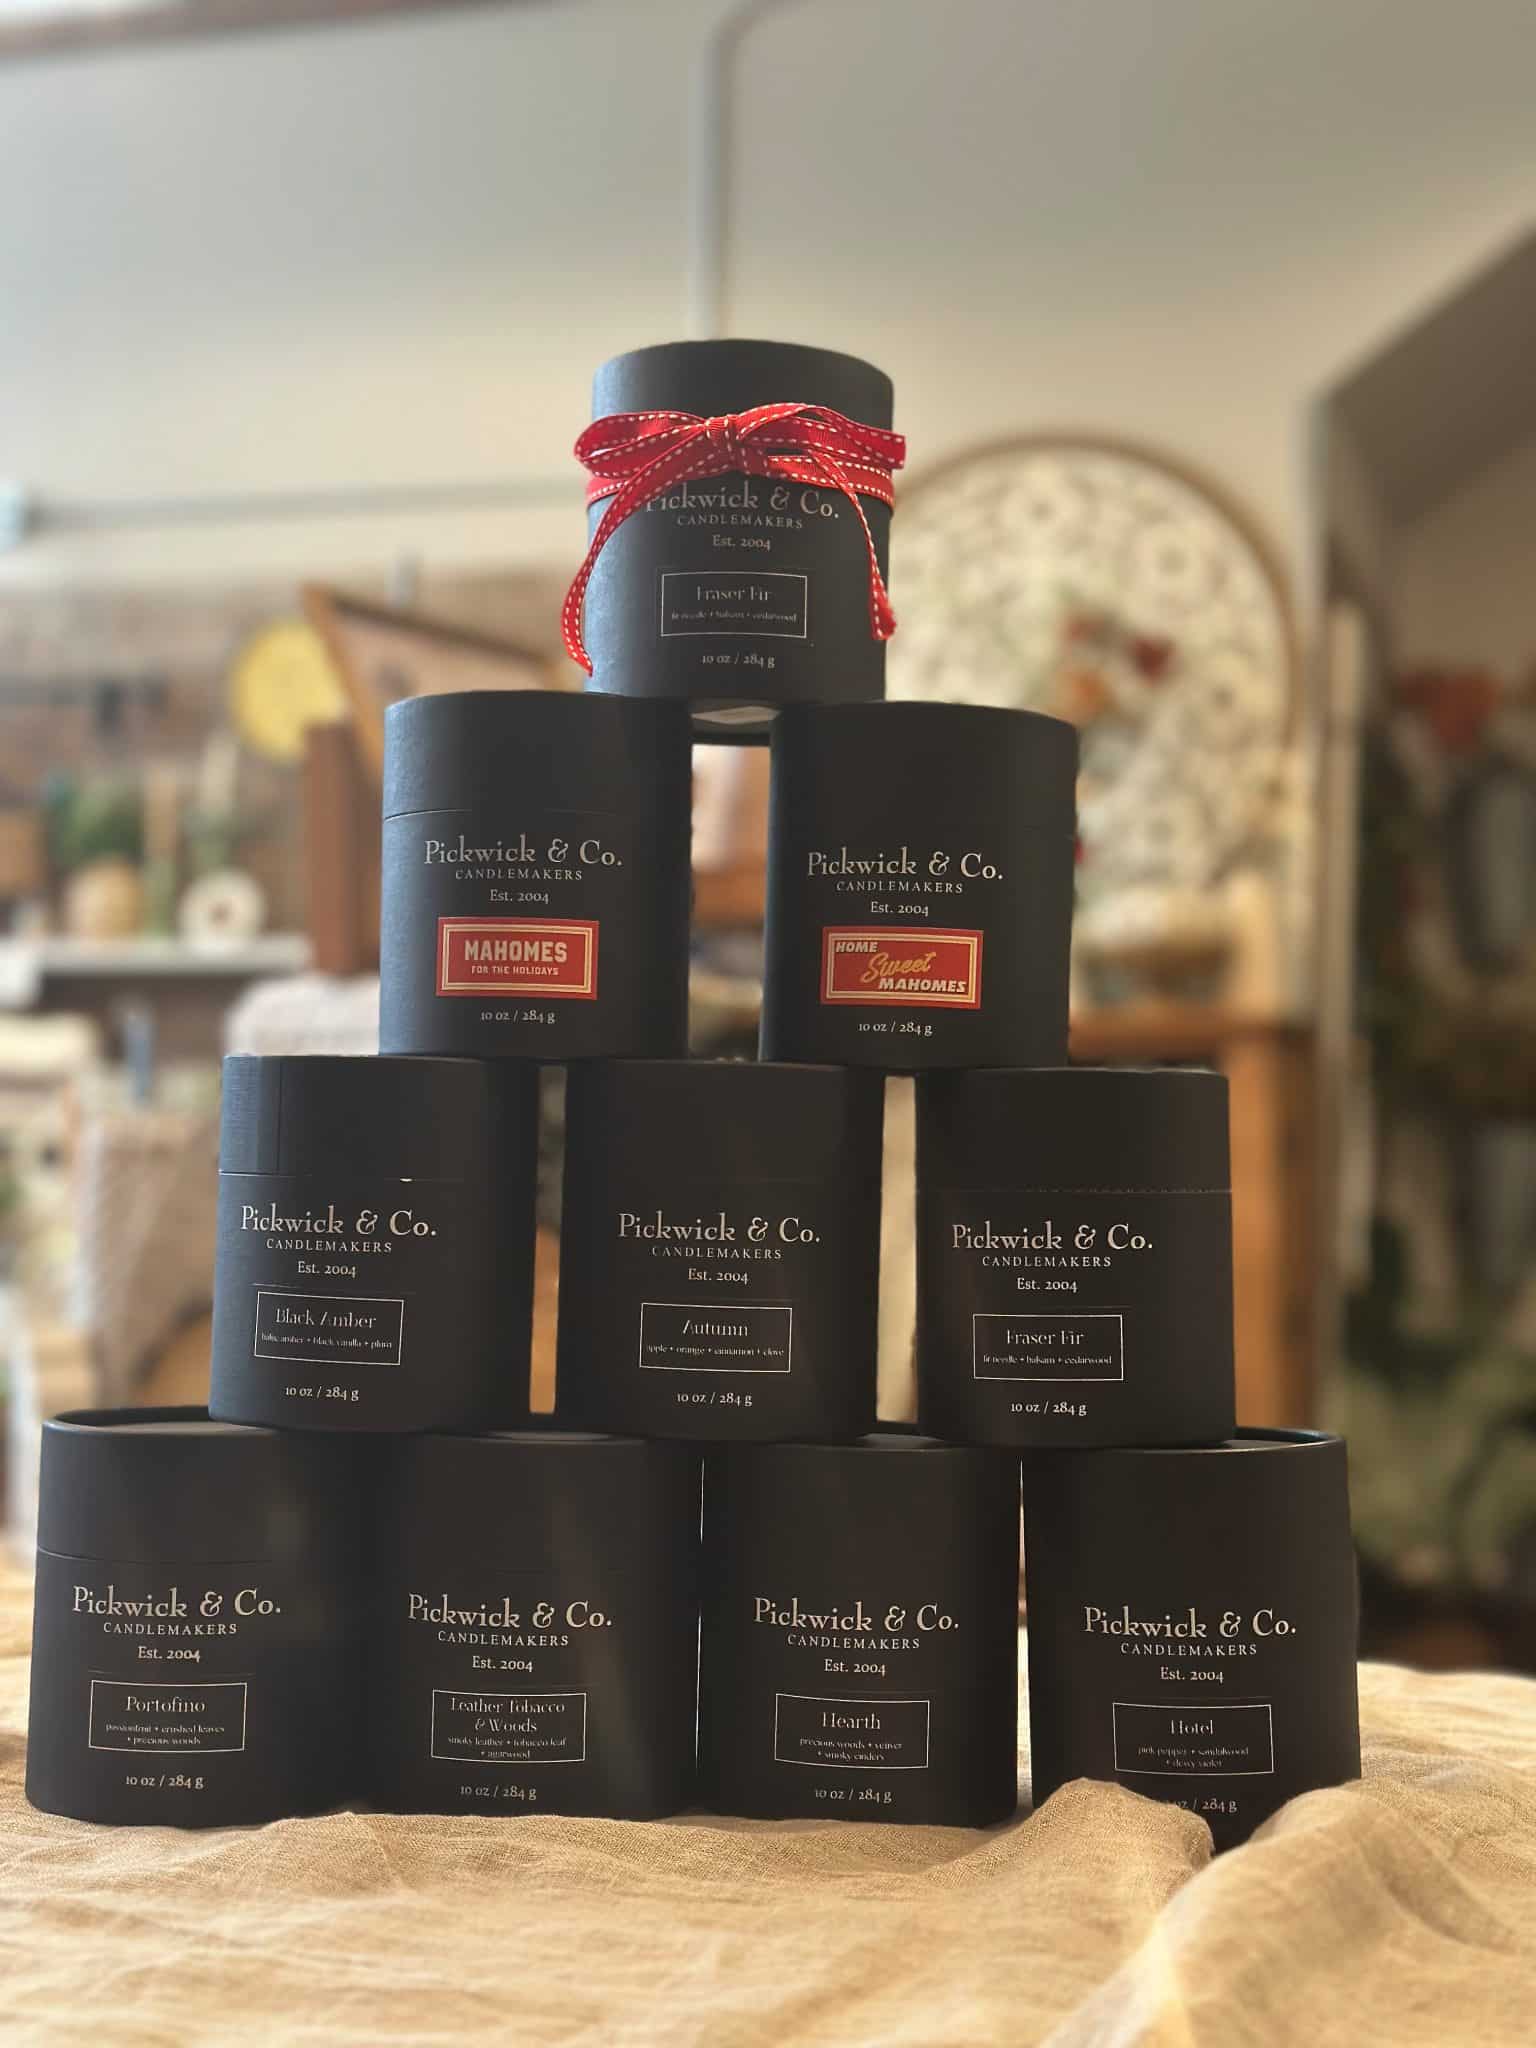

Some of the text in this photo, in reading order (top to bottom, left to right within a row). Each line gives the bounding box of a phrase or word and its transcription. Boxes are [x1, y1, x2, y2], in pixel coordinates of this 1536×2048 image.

[770, 487, 790, 510] &
[801, 491, 839, 518] Co.
[677, 514, 802, 528] CANDLEMAKERS
[712, 534, 770, 551] Est. 2004
[744, 654, 763, 667] 284
[423, 832, 621, 865] Pickwick & Co.
[809, 847, 1002, 879] Pickwick & Co.
[456, 869, 582, 880] CANDLEMAKERS
[837, 881, 963, 893] CANDLEMAKERS
[490, 889, 548, 904] Est. 2004
[871, 901, 928, 917] Est. 2004
[464, 940, 568, 962] MAHOMES
[836, 942, 880, 954] HOME
[472, 966, 558, 975] FOR THE HOLIDAYS
[860, 950, 938, 984] Sweet
[879, 978, 967, 993] MAHOMES
[523, 1010, 543, 1023] 284
[900, 1022, 921, 1035] 284
[239, 1203, 436, 1235] Pickwick & Co.
[619, 1211, 820, 1242] Pickwick & Co.
[953, 1221, 1152, 1249] Pickwick & Co.
[267, 1239, 391, 1252] CANDLEMAKERS
[653, 1247, 781, 1259] CANDLEMAKERS
[983, 1256, 1111, 1267] CANDLEMAKERS
[298, 1261, 355, 1278] Est. 2004
[689, 1268, 748, 1284] Est. 2004
[1018, 1278, 1077, 1293] Est. 2004
[276, 1308, 314, 1325] Black
[683, 1320, 748, 1336] Autumn
[1007, 1330, 1083, 1344] Fraser Fir
[299, 1388, 312, 1396] oz
[326, 1387, 347, 1400] 284
[720, 1393, 740, 1406] 284
[1012, 1403, 1022, 1412] 10
[1026, 1404, 1040, 1412] oz
[1053, 1402, 1074, 1415] 284
[72, 1585, 280, 1616] Pickwick & Co.
[409, 1593, 611, 1628] Pickwick & Co.
[755, 1598, 958, 1631] Pickwick & Co.
[104, 1622, 237, 1635] CANDLEMAKERS
[1085, 1606, 1296, 1637] Pickwick & Co.
[439, 1631, 568, 1646] CANDLEMAKERS
[788, 1635, 920, 1649] CANDLEMAKERS
[138, 1646, 200, 1662] Est. 2004
[1121, 1643, 1256, 1656] CANDLEMAKERS
[473, 1656, 532, 1672] Est. 2004
[825, 1659, 885, 1676] Est. 2004
[1161, 1667, 1224, 1683] Est. 2004
[127, 1696, 205, 1712] Portofino
[451, 1698, 565, 1713] Leather Tobacco
[489, 1718, 536, 1732] Woods
[823, 1712, 880, 1729] Hearth
[1172, 1720, 1213, 1734] Hotel
[126, 1776, 137, 1785] 10
[141, 1777, 155, 1786] oz
[169, 1775, 192, 1788] 284
[504, 1786, 524, 1800] 284
[831, 1791, 844, 1799] oz
[859, 1789, 879, 1803] 284
